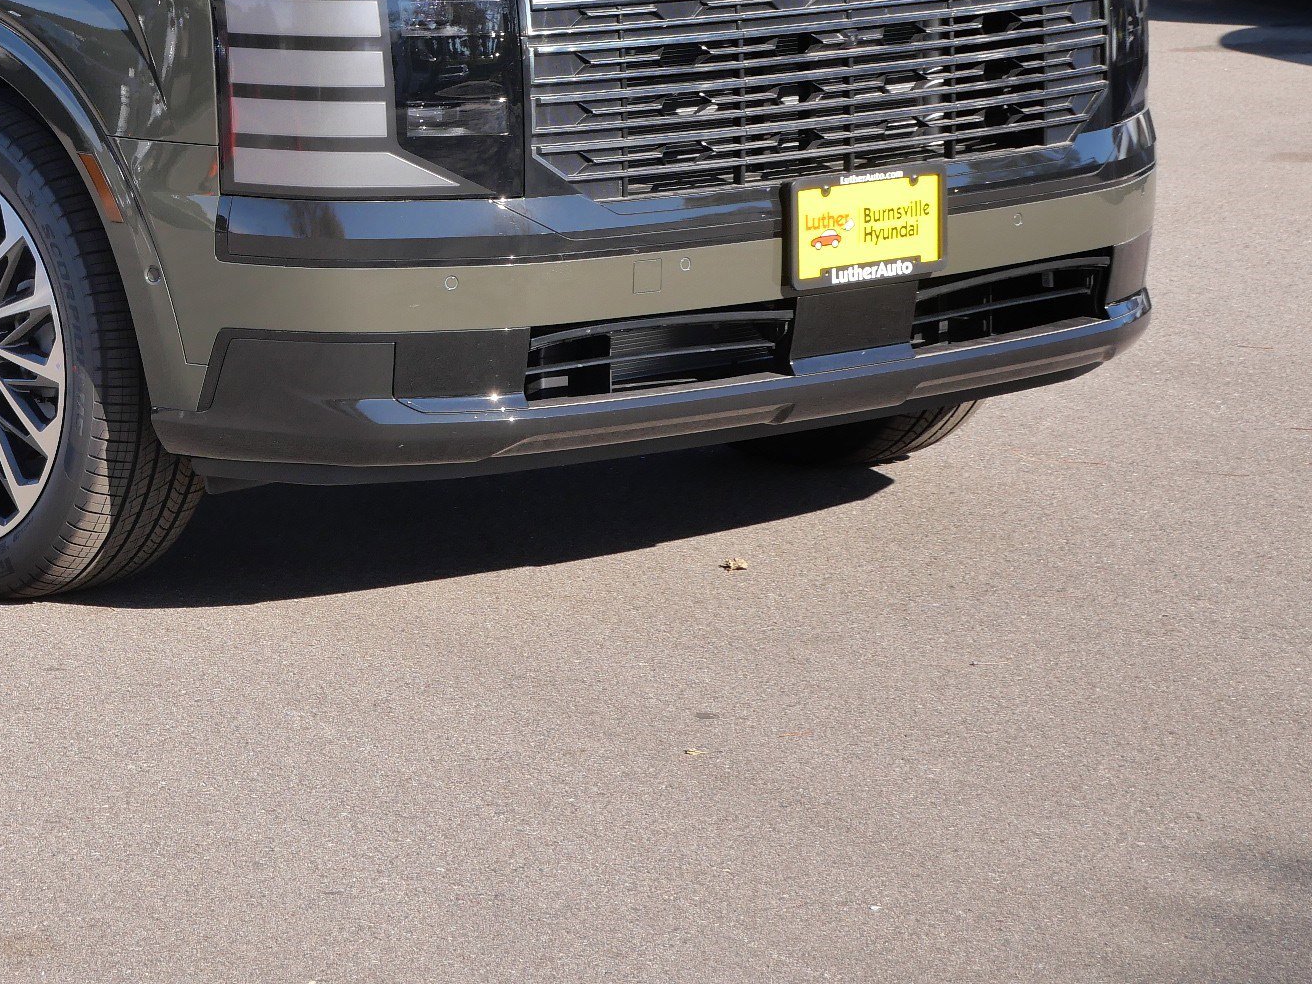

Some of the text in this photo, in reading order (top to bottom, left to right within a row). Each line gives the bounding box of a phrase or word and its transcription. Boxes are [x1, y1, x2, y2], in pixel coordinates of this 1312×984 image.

[839, 170, 904, 185] LutherAuto.com
[805, 212, 851, 231] Luther
[863, 200, 931, 224] Burnsville
[863, 219, 920, 246] Hyundai
[831, 259, 914, 285] LutherAuto
